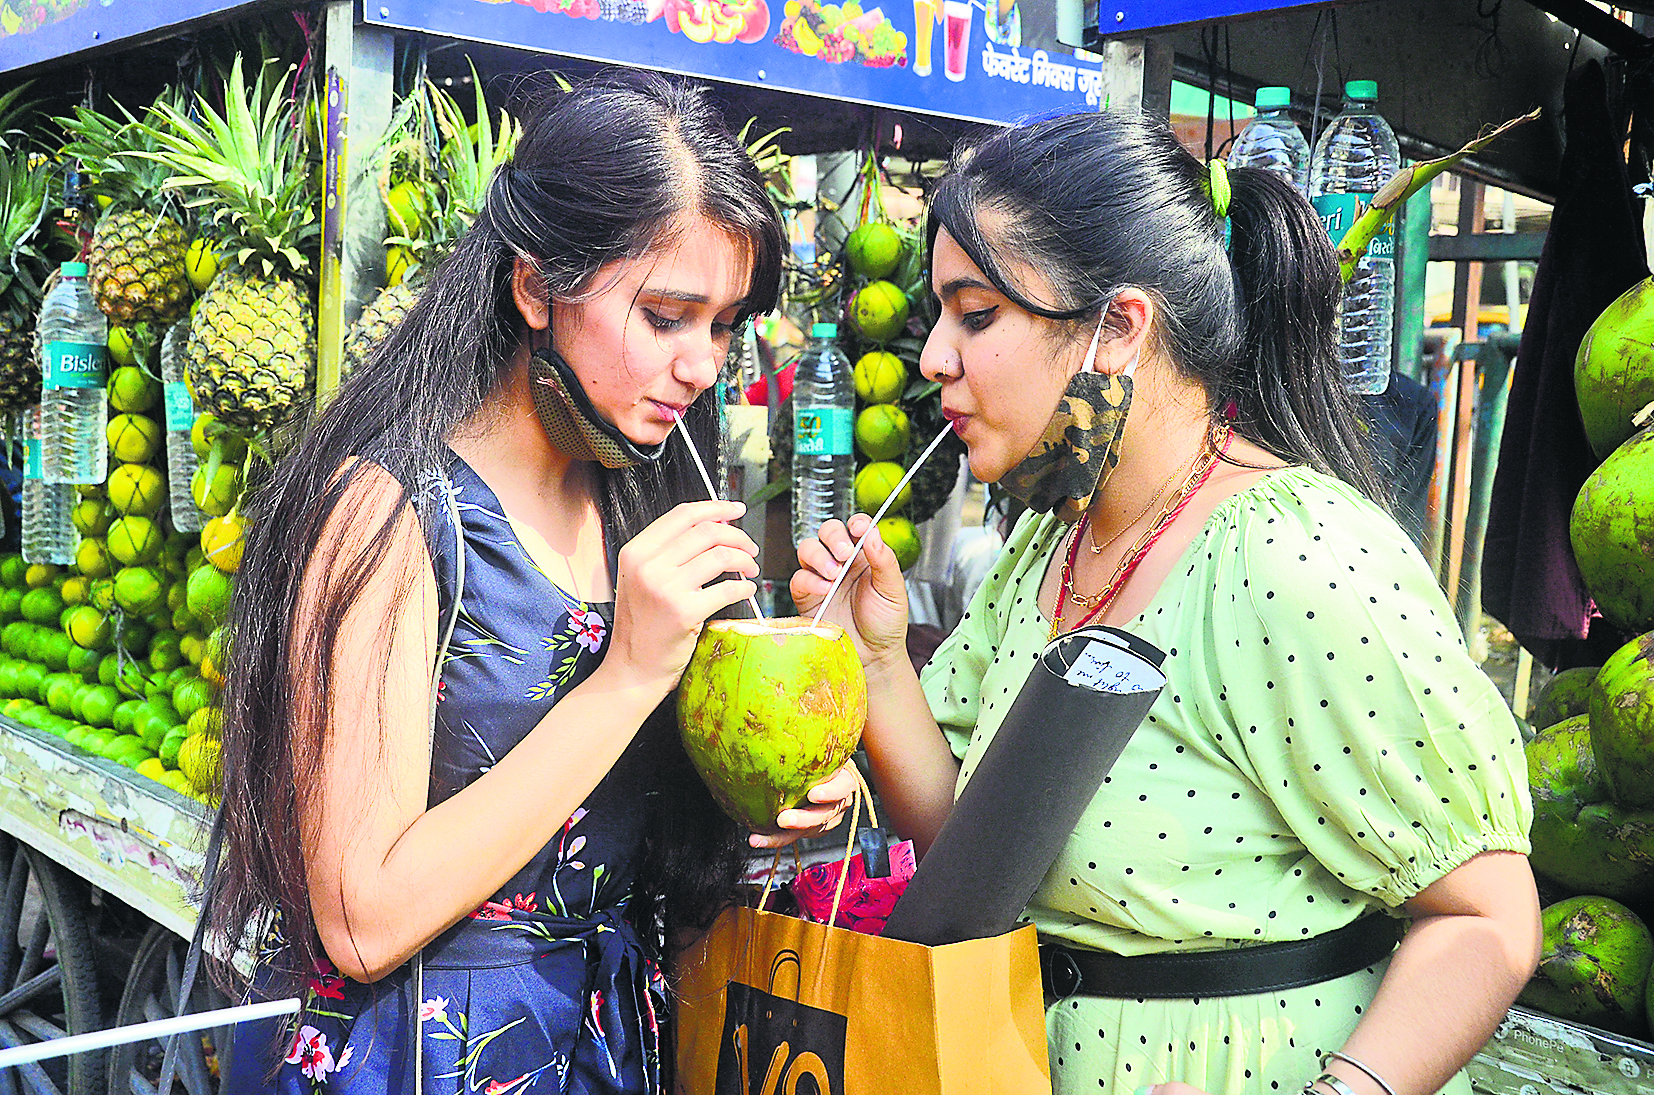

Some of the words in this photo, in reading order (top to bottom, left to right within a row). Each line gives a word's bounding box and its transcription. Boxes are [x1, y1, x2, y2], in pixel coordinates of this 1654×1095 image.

[982, 41, 1031, 84] फेवरेट
[1032, 50, 1076, 92] मिक्स
[1514, 1030, 1564, 1053] PhonePe
